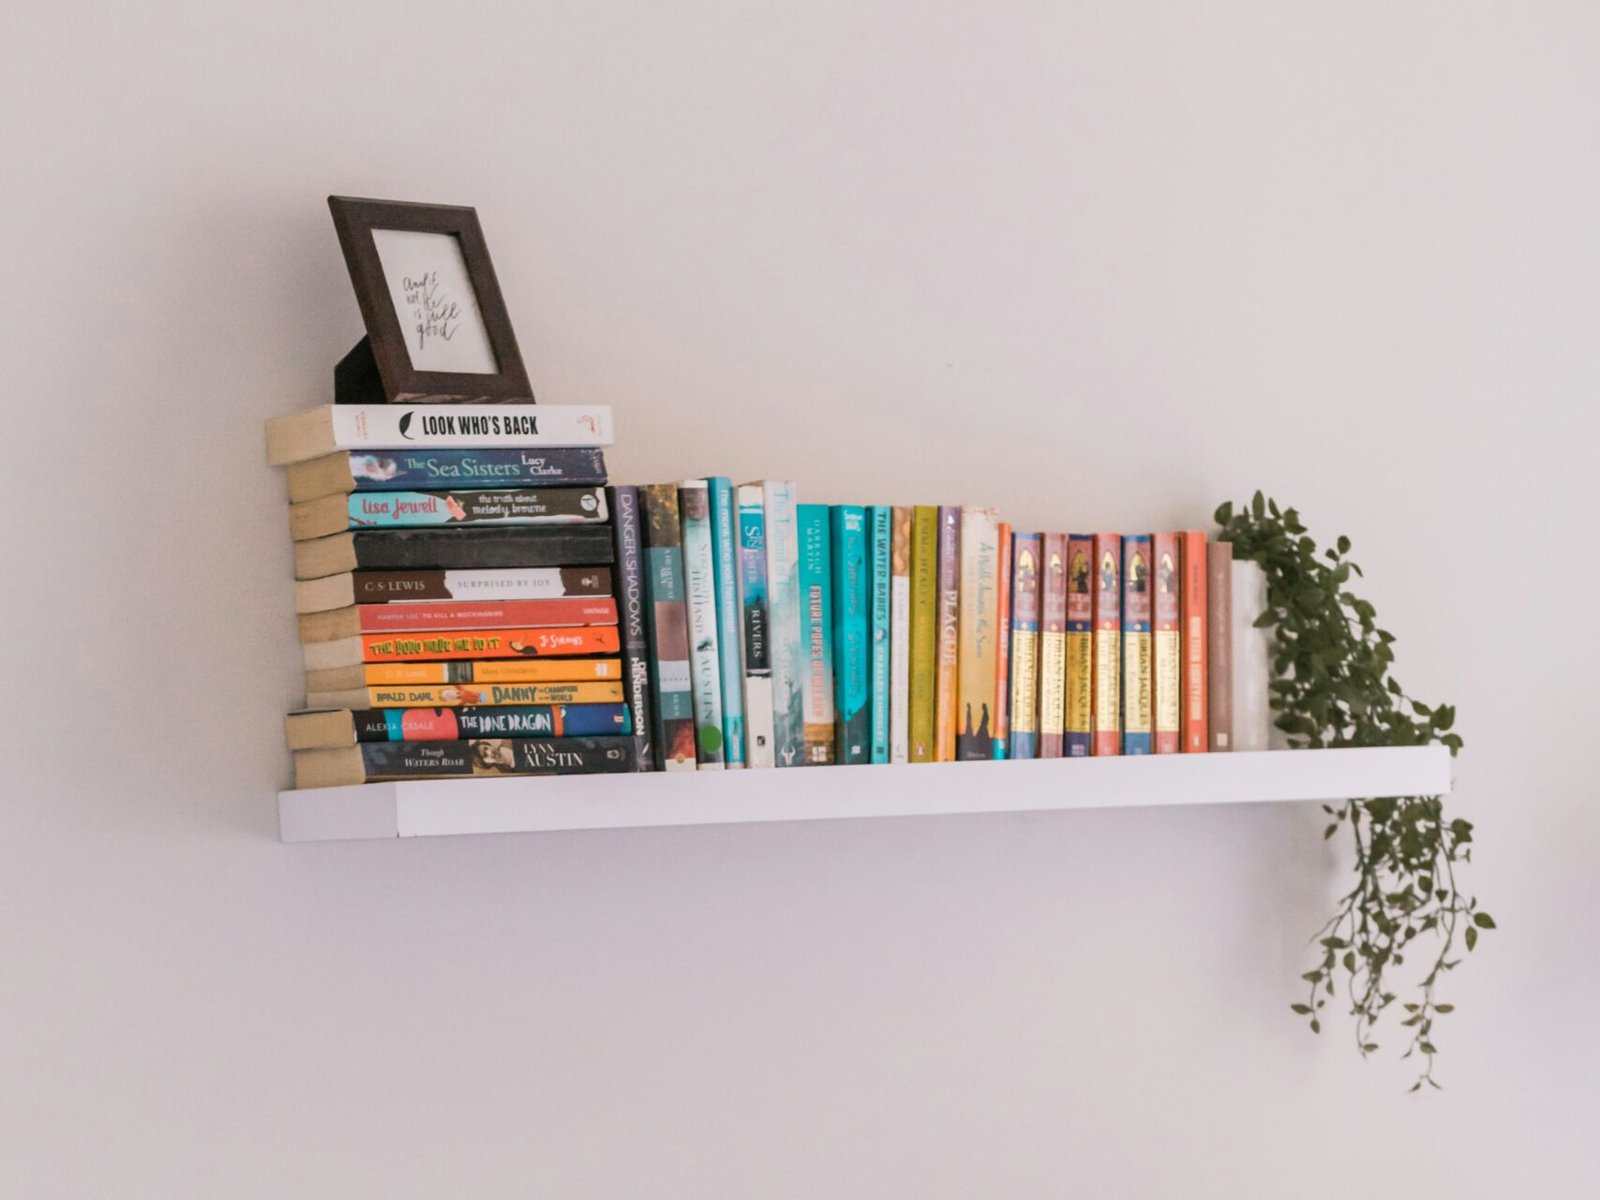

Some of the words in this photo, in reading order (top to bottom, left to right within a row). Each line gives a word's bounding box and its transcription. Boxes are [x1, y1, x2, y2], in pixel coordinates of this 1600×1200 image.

[422, 415, 456, 435] LOOK
[459, 415, 500, 435] WHO'S
[504, 415, 538, 435] BACK
[405, 458, 425, 469] The
[427, 458, 461, 477] Sea
[461, 457, 521, 476] Sisters
[521, 453, 545, 466] Lucy
[529, 466, 562, 475] Clarke
[478, 495, 491, 503] the
[493, 495, 513, 503] truth
[515, 494, 537, 503] about
[472, 504, 509, 517] melody
[512, 503, 546, 513] browne
[620, 494, 636, 556] DANGER
[877, 512, 887, 534] THE
[388, 581, 426, 591] LEWIS
[457, 581, 514, 589] SURPRISED
[517, 580, 529, 588] BY
[625, 559, 641, 636] SHADOWS
[809, 585, 822, 622] FUTURE
[751, 609, 762, 658] RIVERS
[944, 590, 958, 665] PLAGUE
[1140, 638, 1148, 674] BRIAN
[492, 685, 537, 704] DANNY
[631, 657, 644, 735] HENDERSON
[702, 656, 714, 720] AUSTIN
[366, 723, 397, 732] ALEXIA
[402, 721, 434, 731] CASALE
[461, 716, 478, 729] THE
[479, 715, 507, 733] BONE
[507, 713, 552, 732] DRAGON
[524, 752, 583, 768] AUSTIN
